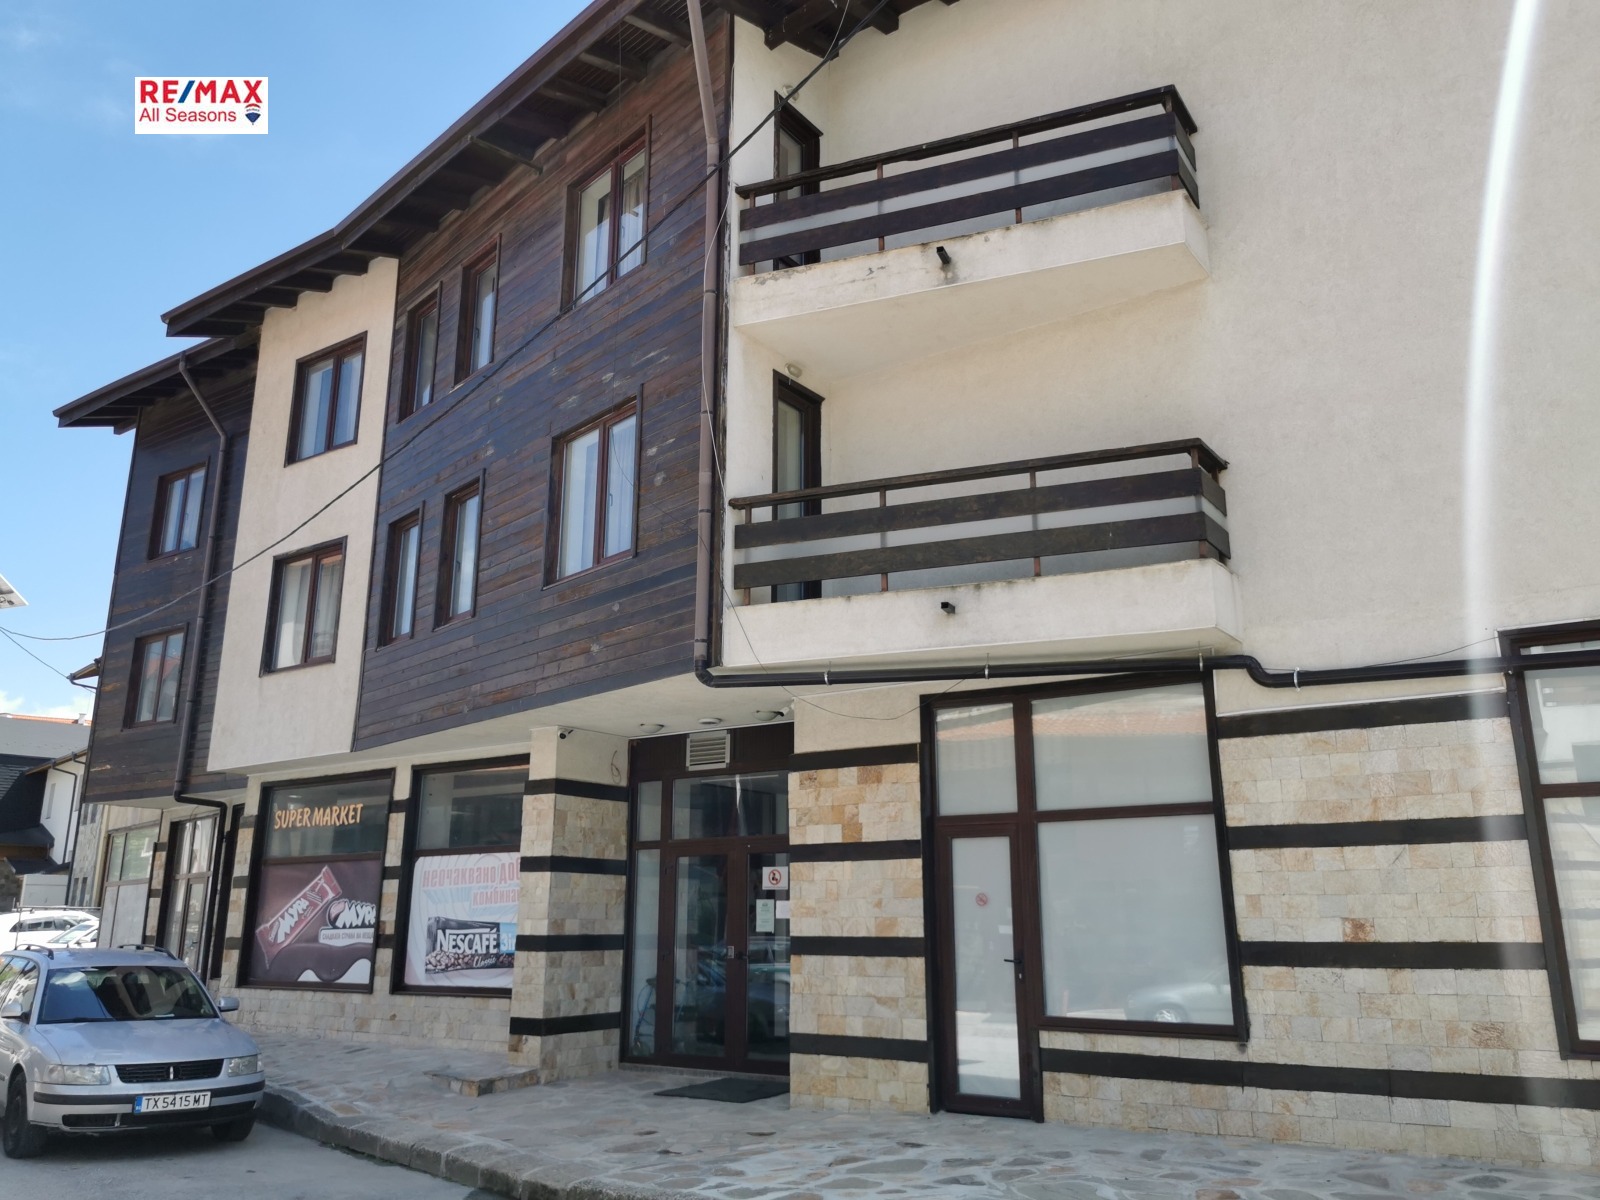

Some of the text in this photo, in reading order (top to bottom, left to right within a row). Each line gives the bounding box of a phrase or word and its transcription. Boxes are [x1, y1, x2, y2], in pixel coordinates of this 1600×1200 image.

[274, 803, 364, 829] SUPER MARKET
[436, 927, 498, 954] NESCAFÉ
